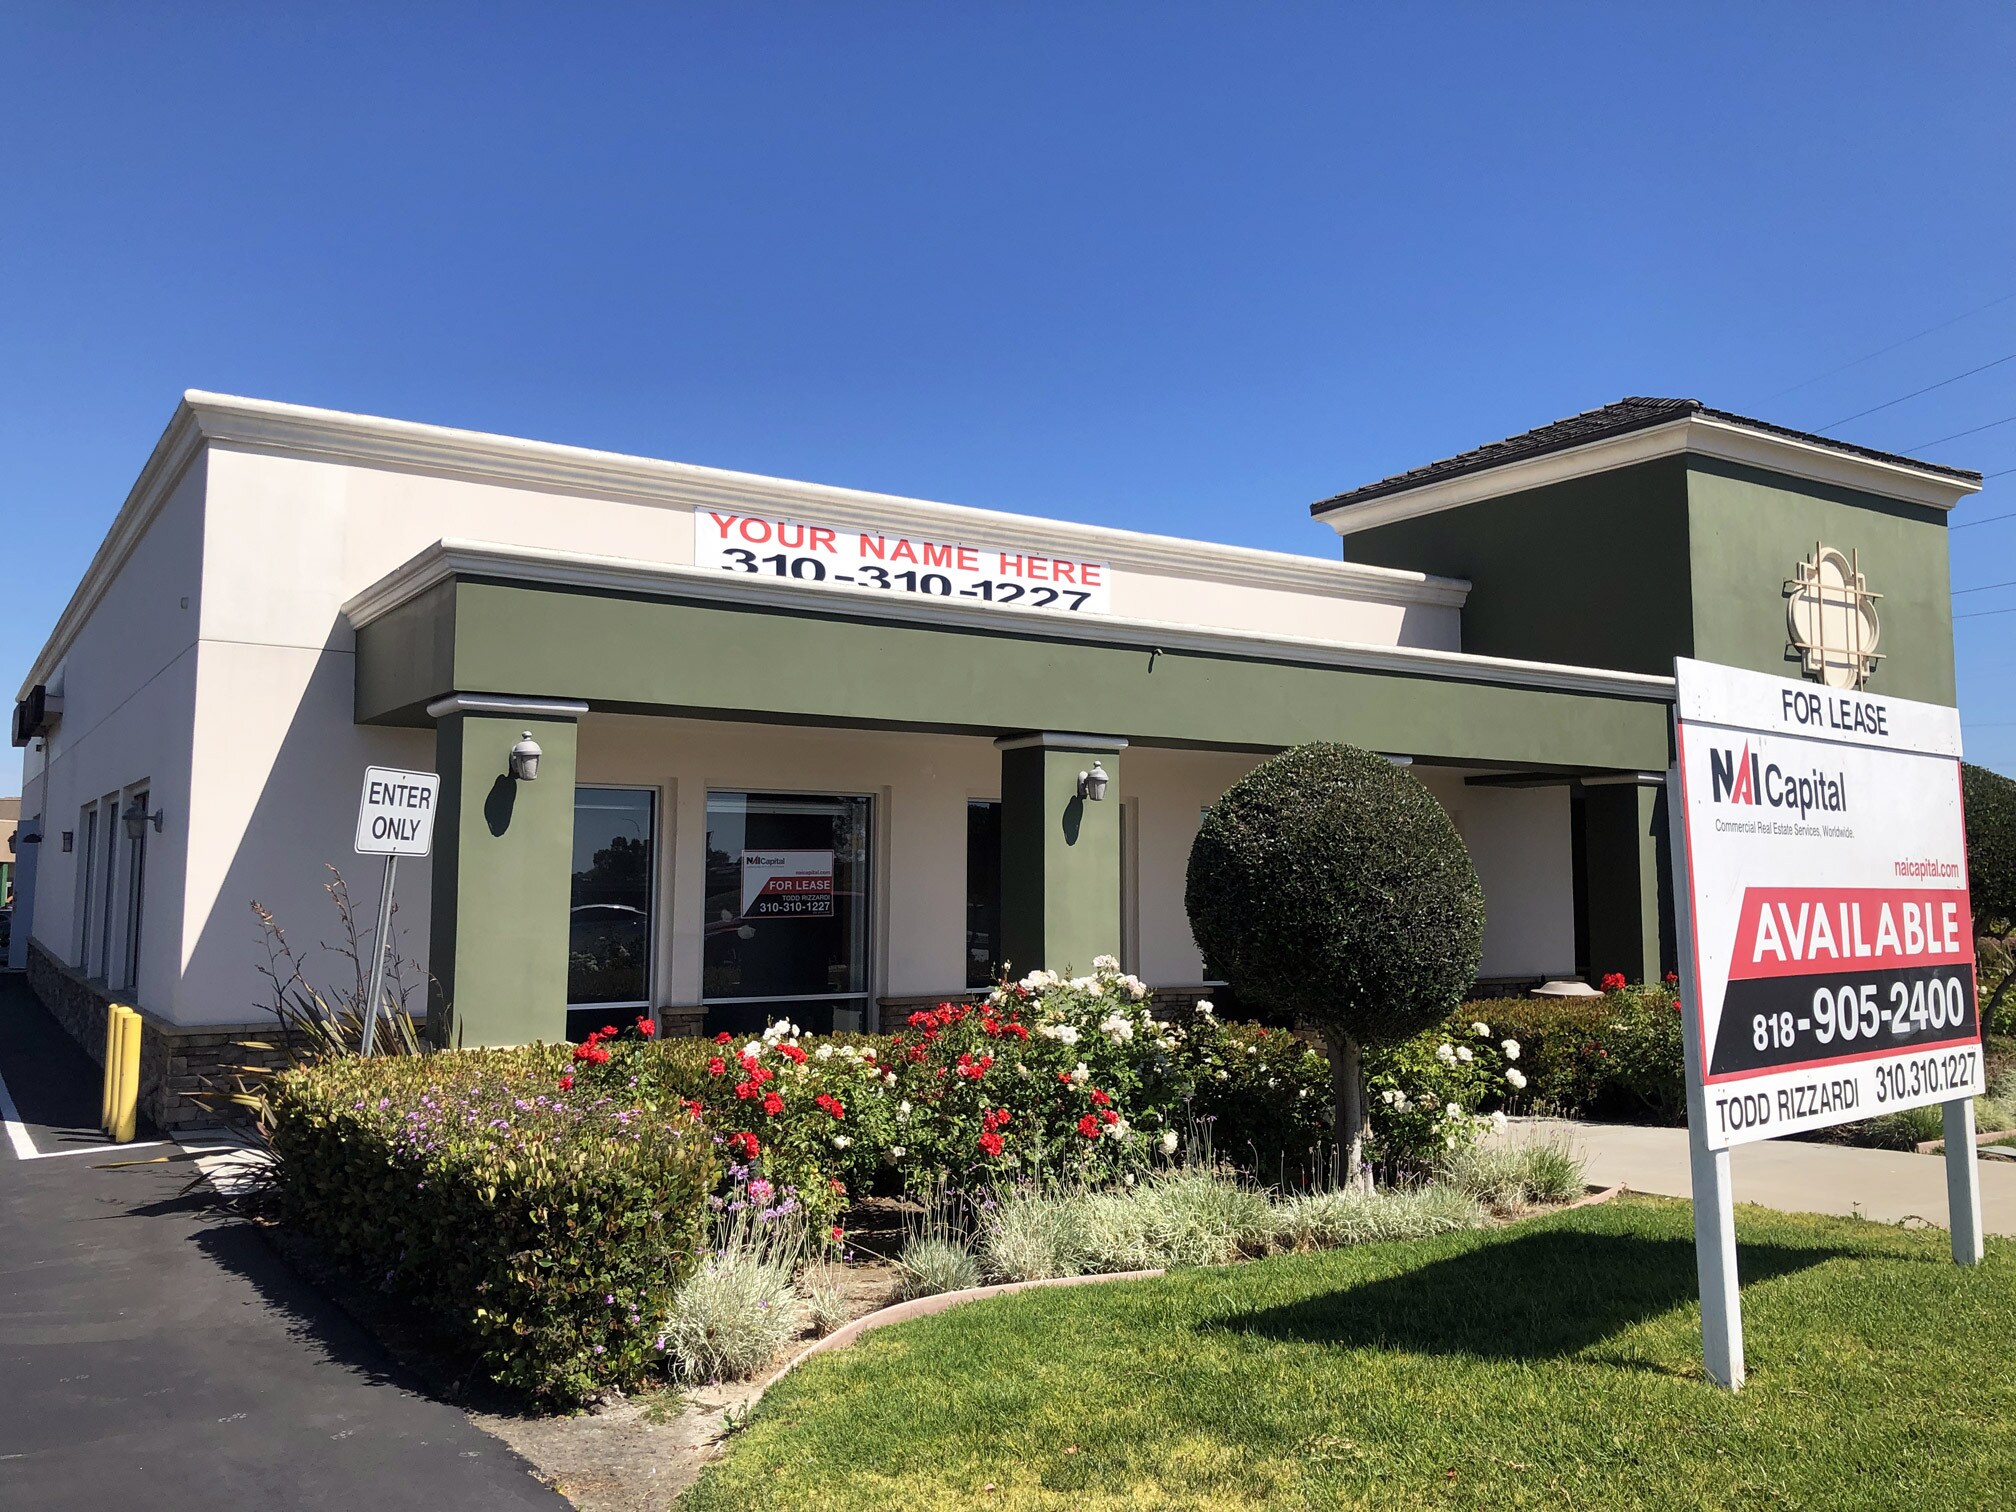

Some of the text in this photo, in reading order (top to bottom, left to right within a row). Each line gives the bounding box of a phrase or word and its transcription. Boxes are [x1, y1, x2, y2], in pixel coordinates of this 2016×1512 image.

[709, 512, 1101, 587] YOUR NAME HERE
[721, 548, 1092, 611] 310-310-1227
[1781, 689, 1889, 736] FOR LEASE
[368, 781, 432, 810] ENTER
[372, 815, 421, 841] ONLY
[1715, 818, 1855, 839] Commercial Real Estate Services, Worldwide.
[769, 880, 830, 891] FOR LEASE
[1895, 857, 1960, 882] naicapital.com
[759, 901, 830, 913] 310-310-1227
[1752, 902, 1960, 963] AVAILABLE
[1752, 976, 1965, 1051] 818-905-2400
[1716, 1052, 1976, 1133] TODD RIZZARDI 310.310.1227
